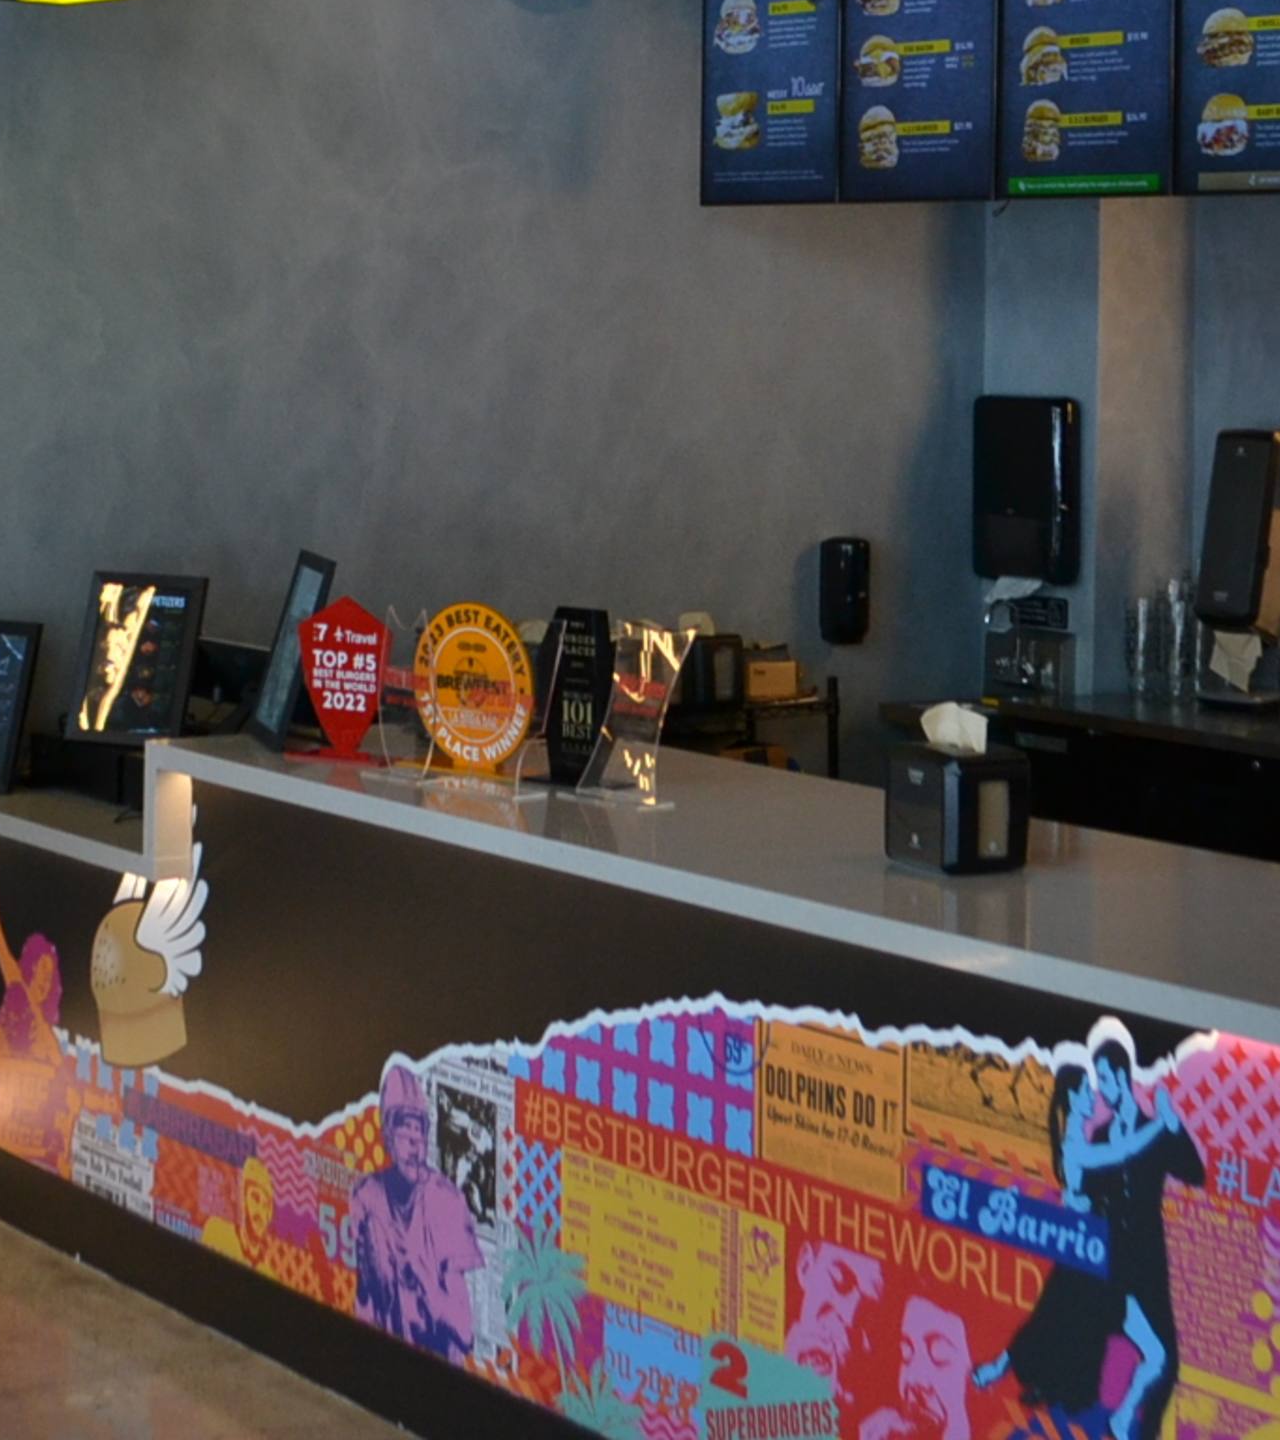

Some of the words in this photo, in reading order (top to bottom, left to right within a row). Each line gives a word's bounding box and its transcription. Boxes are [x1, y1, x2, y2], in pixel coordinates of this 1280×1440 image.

[345, 630, 377, 645] Travel
[445, 608, 481, 628] BEST
[483, 614, 527, 676] EATERY
[312, 648, 349, 669] TOP
[352, 652, 377, 672] #5
[312, 667, 334, 679] BEST
[335, 670, 376, 683] BURGERS
[322, 690, 367, 712] 2022
[342, 681, 376, 694] WORLD
[561, 698, 593, 725] 101
[436, 725, 481, 762] PLACE
[482, 702, 529, 761] WINNER
[561, 722, 592, 740] BEST
[790, 1039, 825, 1062] DAILY
[835, 1054, 874, 1075] NEWS
[765, 1062, 847, 1120] DOLPHINS
[853, 1089, 876, 1129] DO
[882, 1098, 898, 1135] IT
[523, 1089, 1045, 1312] #BESTBURGERINTHEWORLD
[925, 1164, 973, 1223] El
[977, 1184, 1109, 1265] Barrio
[709, 1340, 749, 1400] 2
[705, 1397, 834, 1440] SUPERBURGERS
